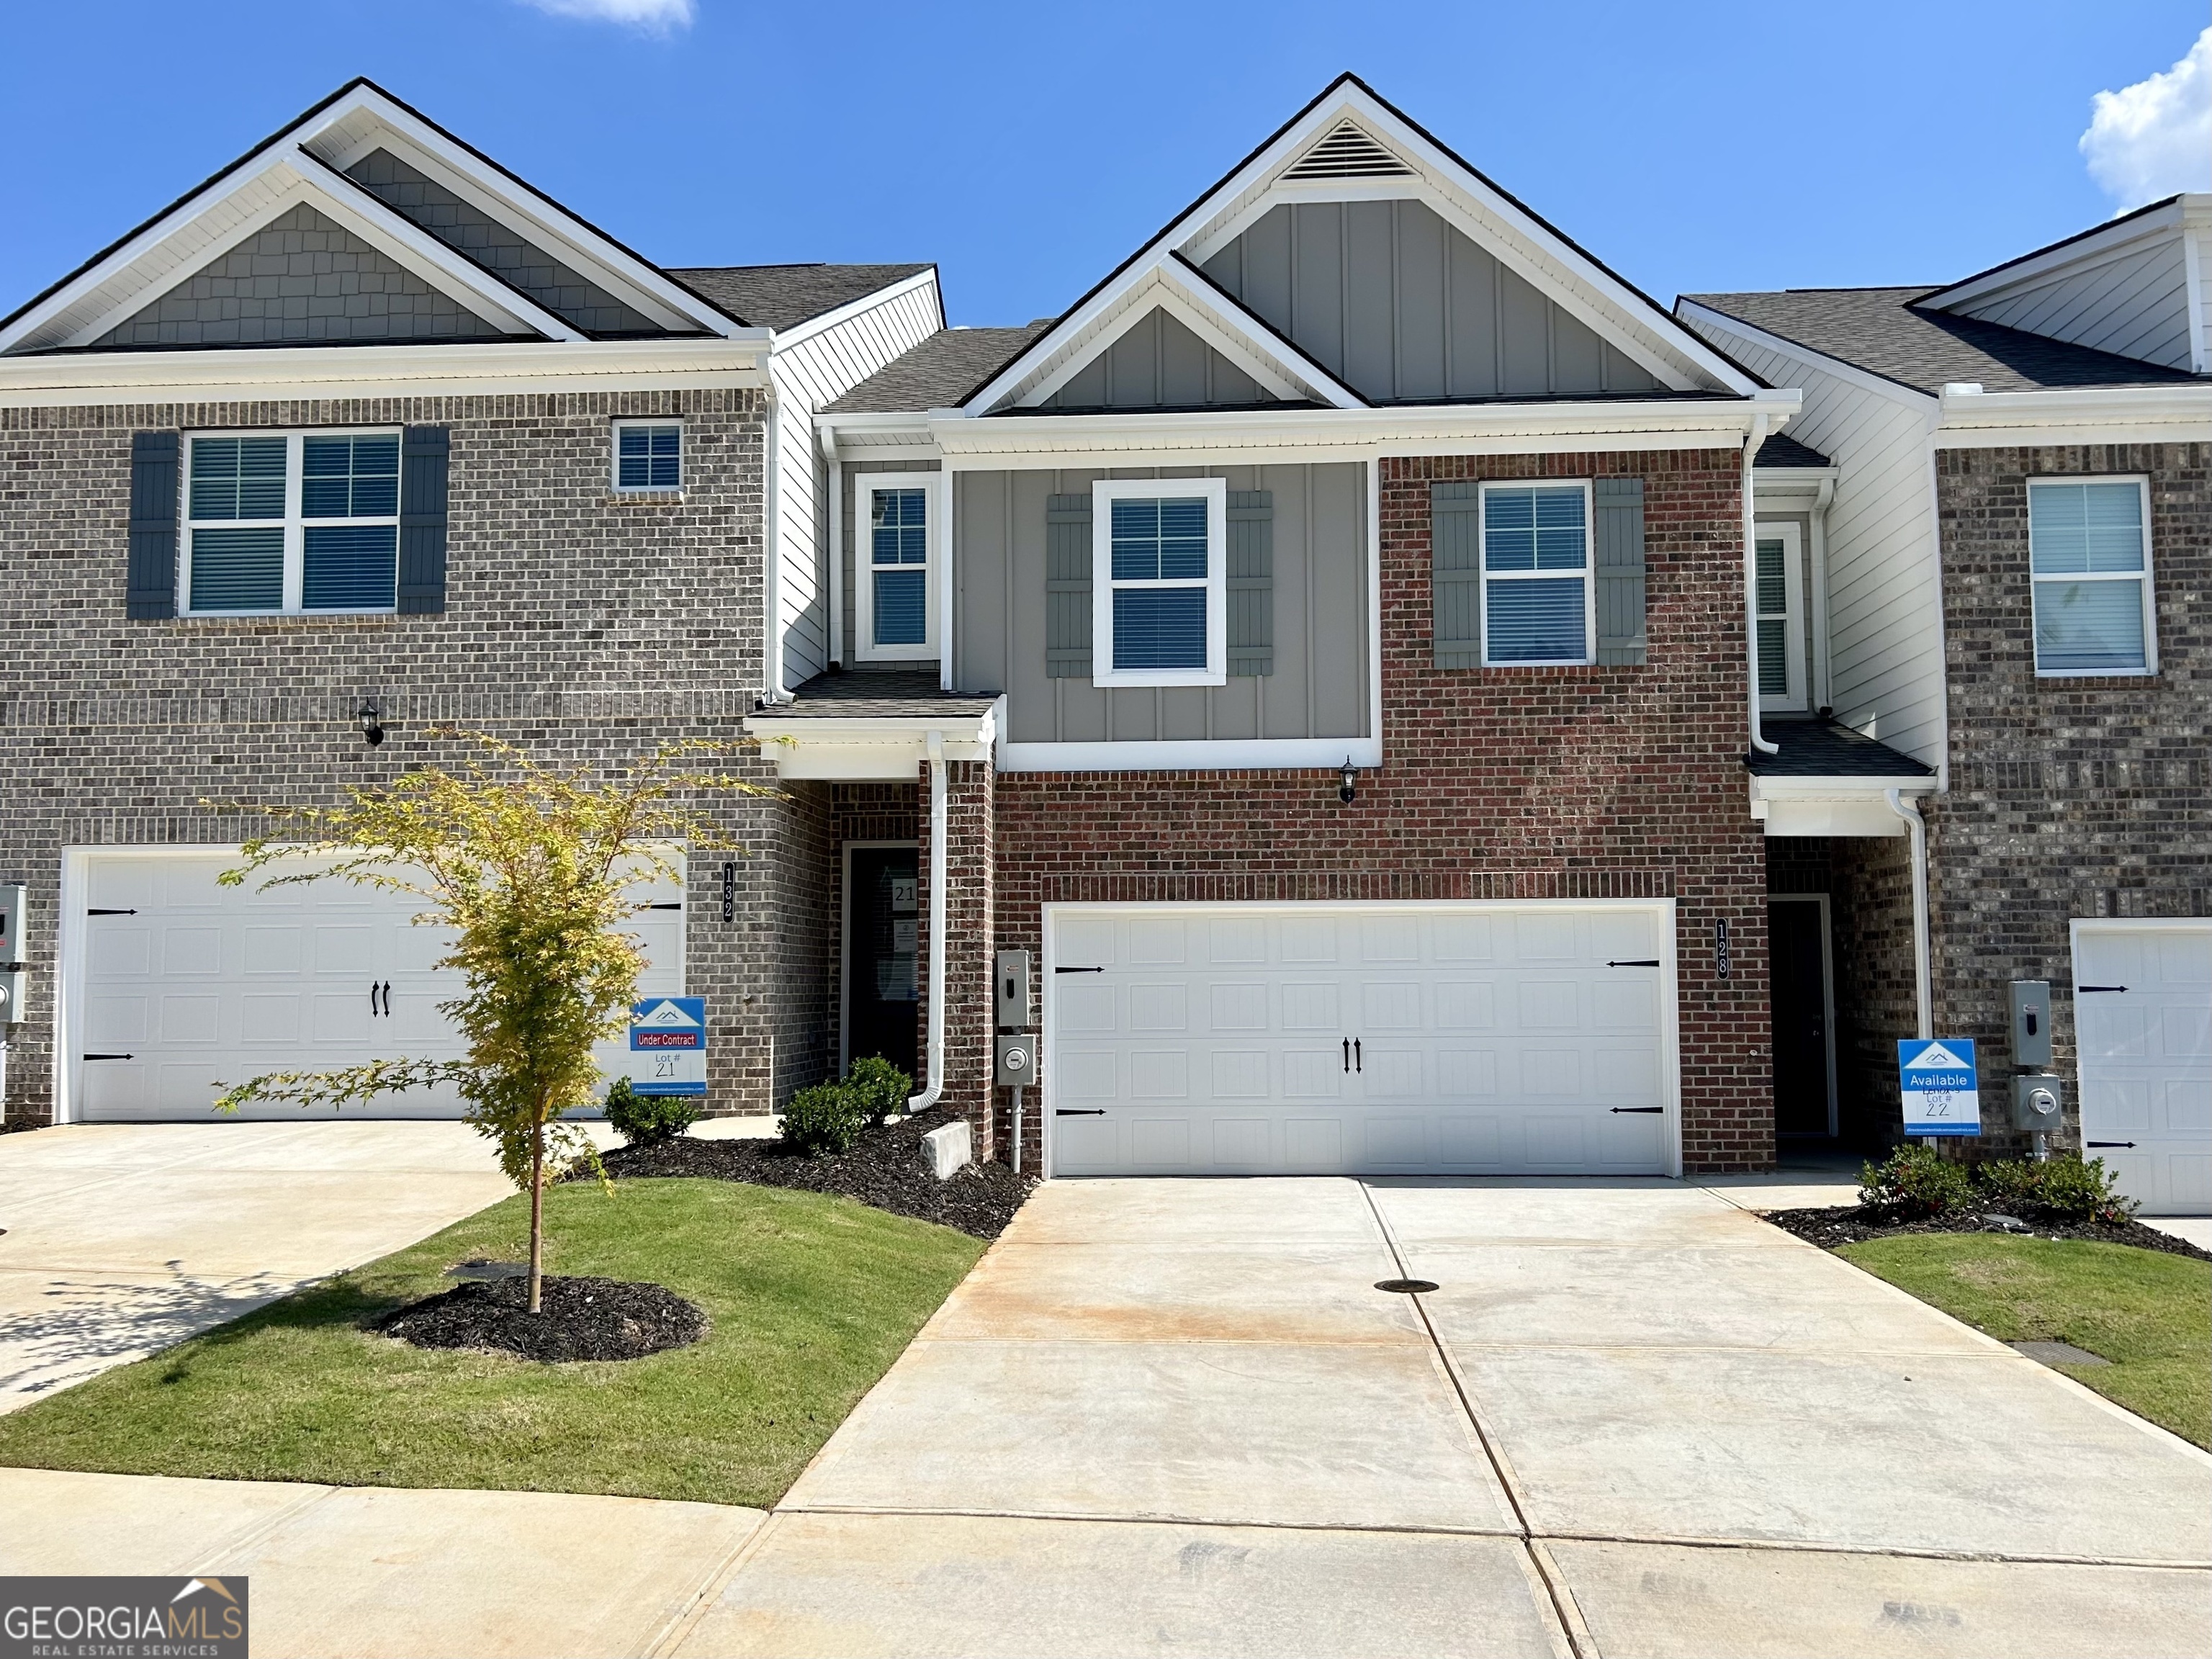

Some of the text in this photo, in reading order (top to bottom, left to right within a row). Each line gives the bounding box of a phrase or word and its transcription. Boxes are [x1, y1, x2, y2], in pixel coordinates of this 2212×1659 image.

[895, 886, 914, 901] 21
[638, 1034, 695, 1046] Under Contract
[674, 1053, 680, 1062] #
[655, 1062, 675, 1077] 21
[1910, 1074, 1967, 1085] Available
[1927, 1094, 1952, 1102] Lot #
[1926, 1102, 1951, 1116] 22
